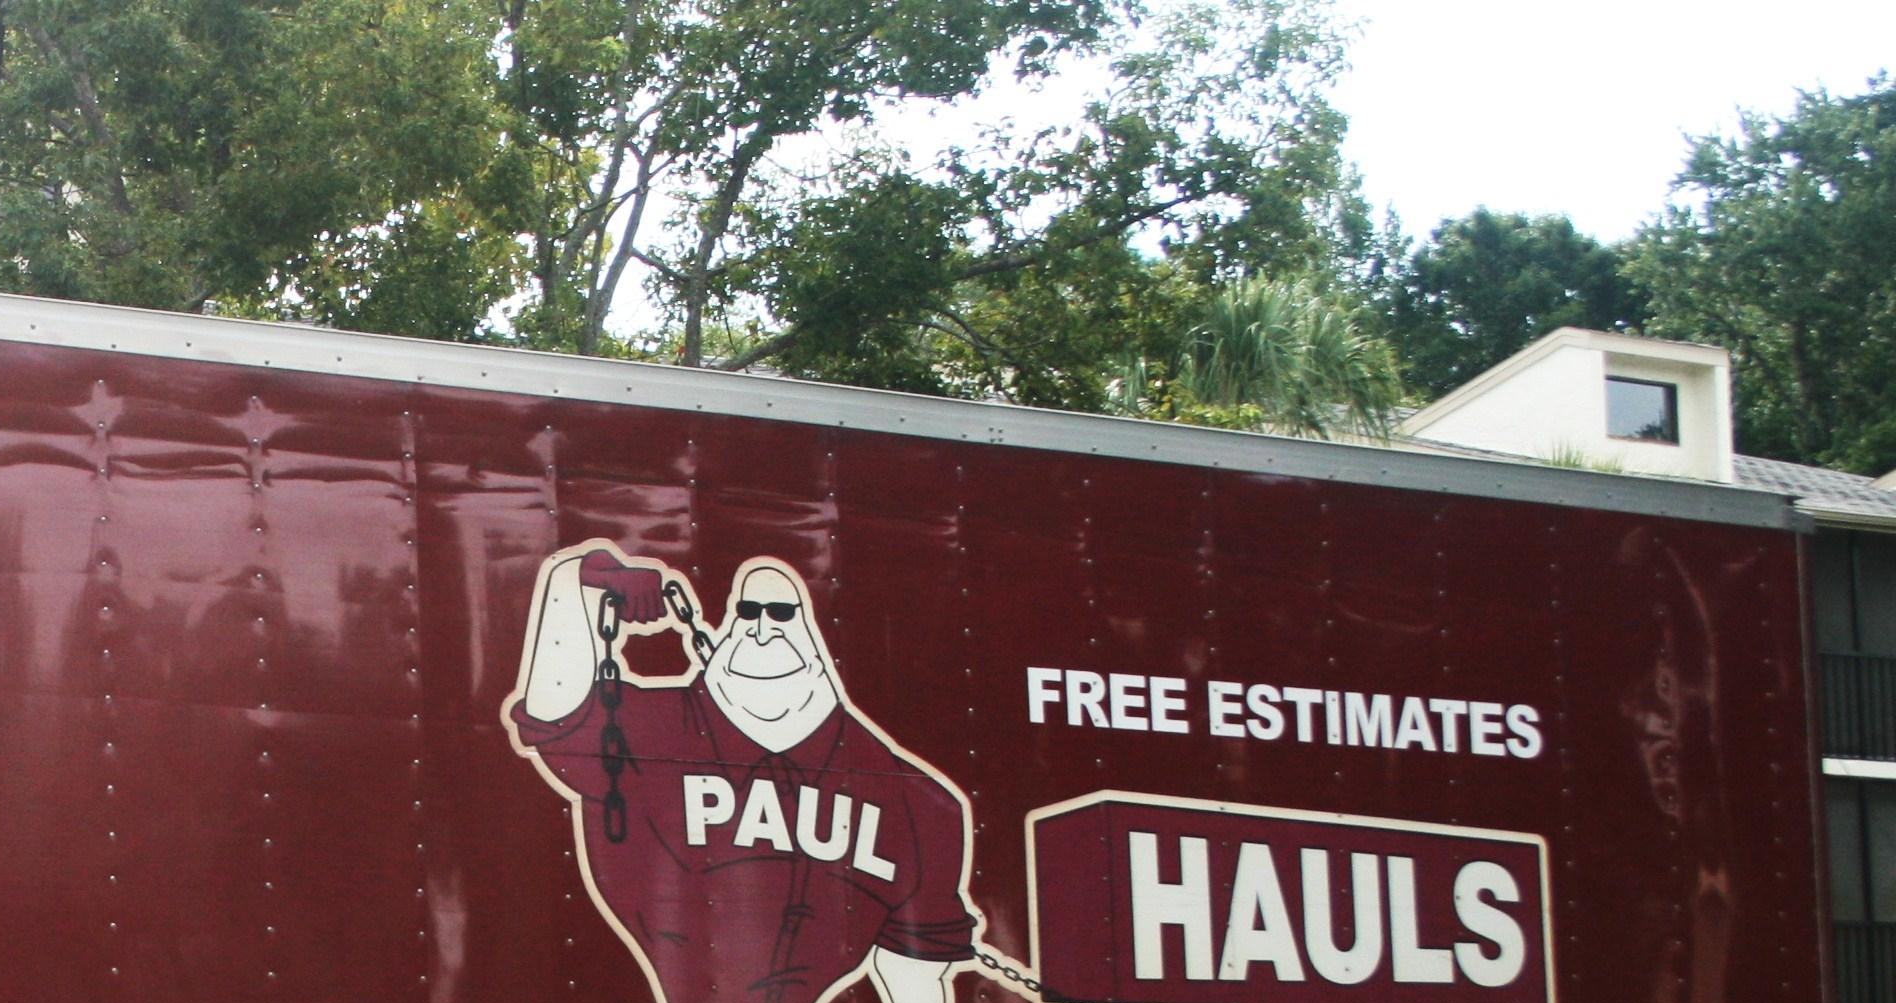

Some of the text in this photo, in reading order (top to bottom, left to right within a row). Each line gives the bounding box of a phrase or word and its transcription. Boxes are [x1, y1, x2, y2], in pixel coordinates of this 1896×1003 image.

[1027, 667, 1542, 759] FREE ESTIMATES
[683, 774, 896, 883] PAUL
[1128, 831, 1526, 988] HAULS
